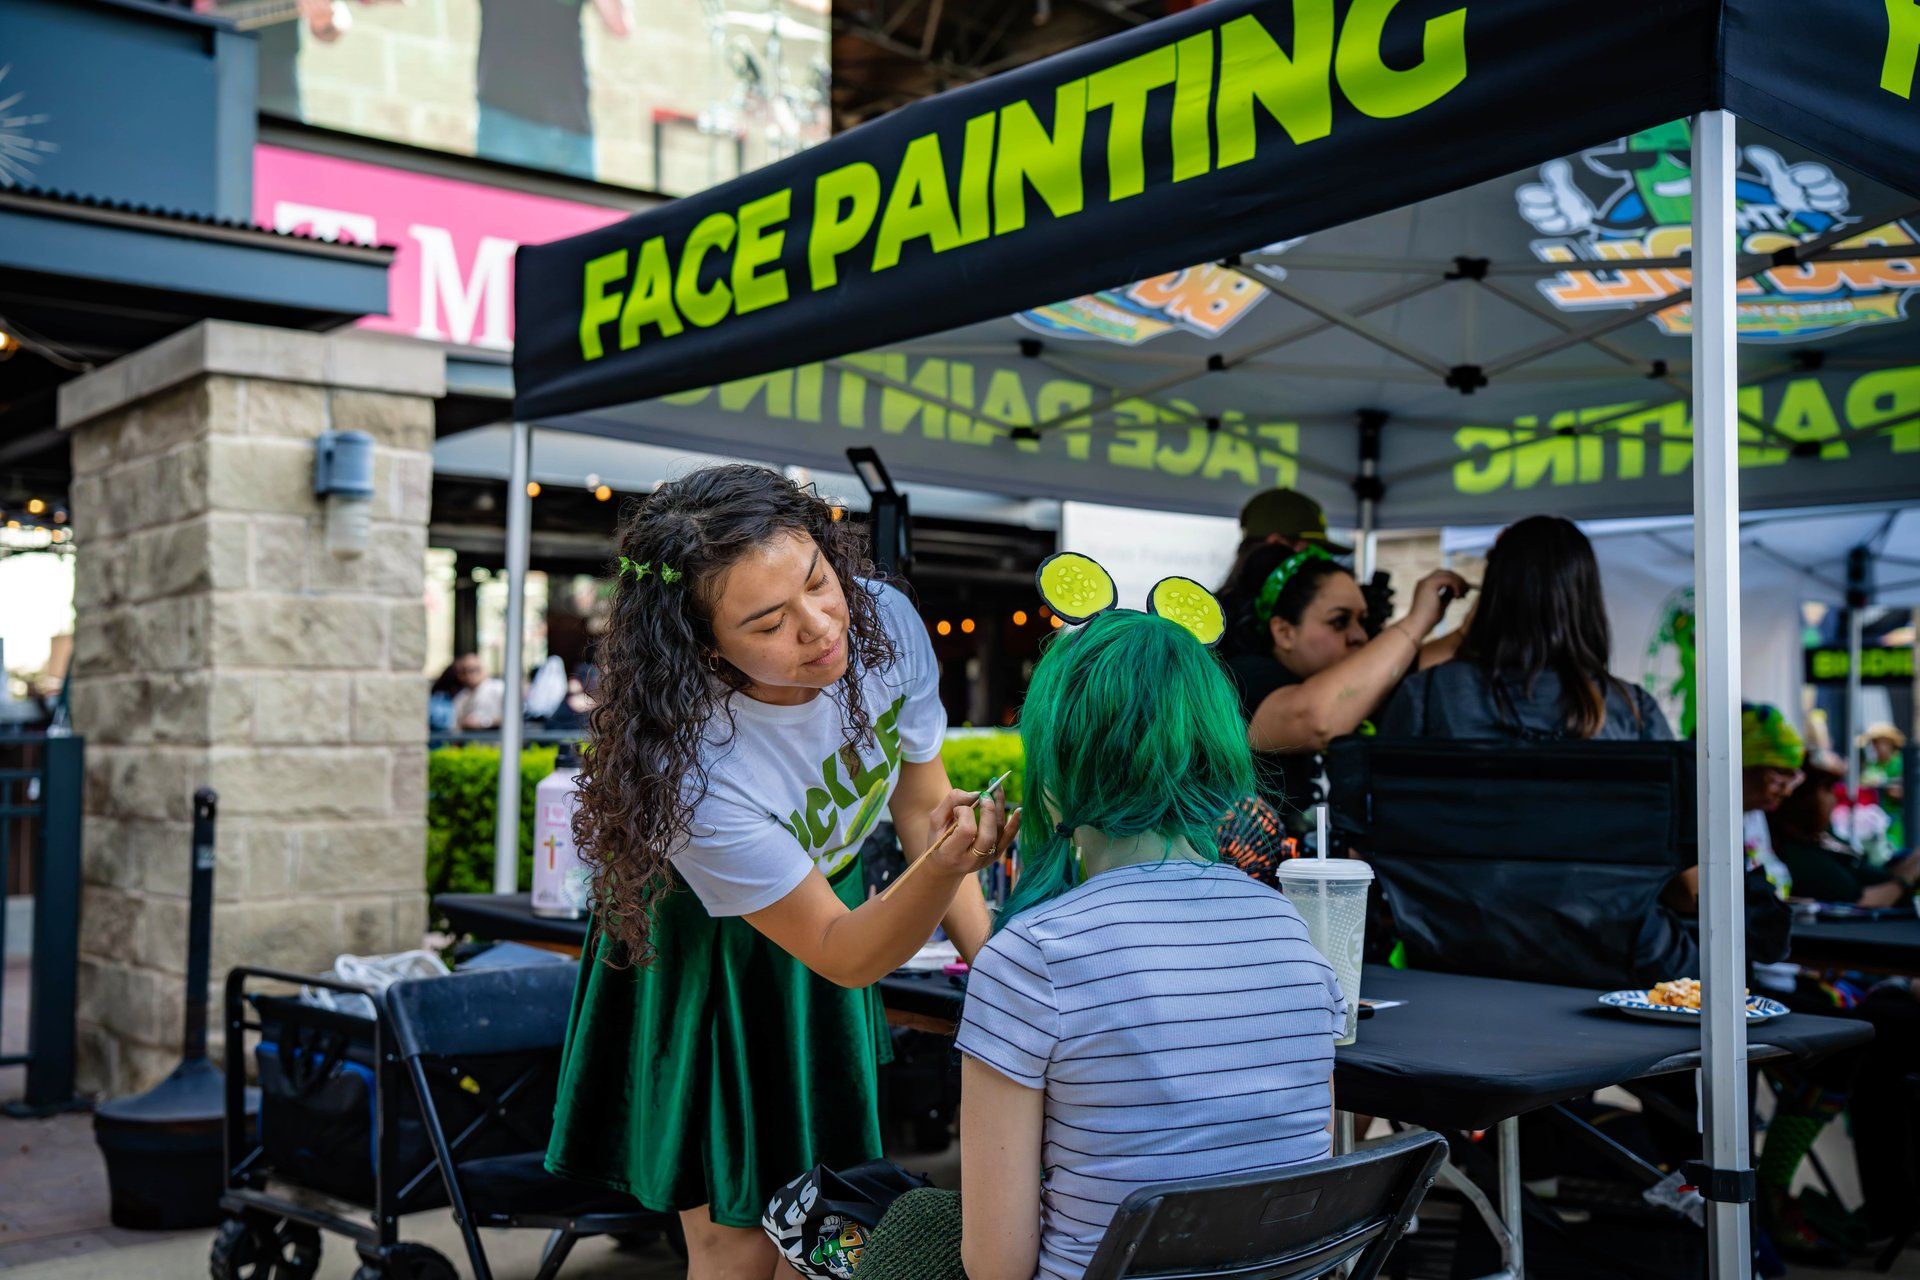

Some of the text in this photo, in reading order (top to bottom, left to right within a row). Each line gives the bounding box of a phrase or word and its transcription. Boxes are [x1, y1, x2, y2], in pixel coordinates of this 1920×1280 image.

[579, 0, 1469, 361] FACE PAINTING
[779, 694, 907, 853] ICKLE
